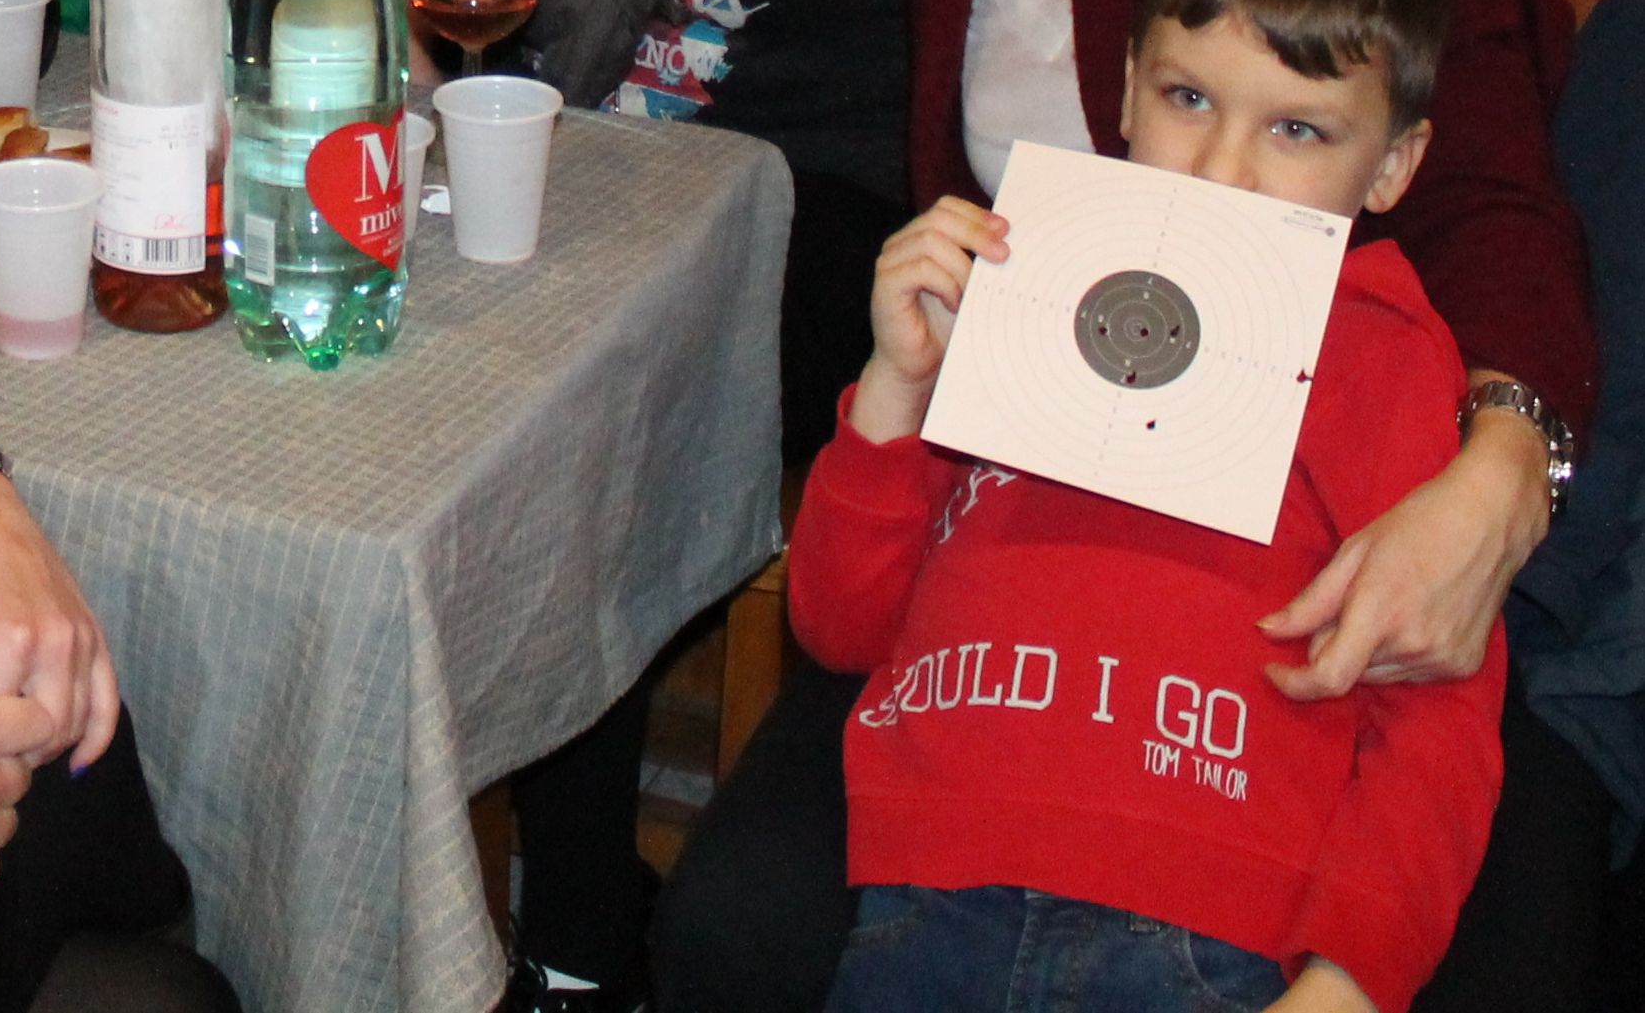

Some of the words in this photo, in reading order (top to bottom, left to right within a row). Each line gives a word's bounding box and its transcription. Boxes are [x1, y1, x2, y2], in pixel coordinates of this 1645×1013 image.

[1091, 655, 1120, 724] I
[1155, 674, 1248, 760] GO
[1142, 739, 1181, 778] TOM
[1192, 755, 1248, 802] TAILOR
